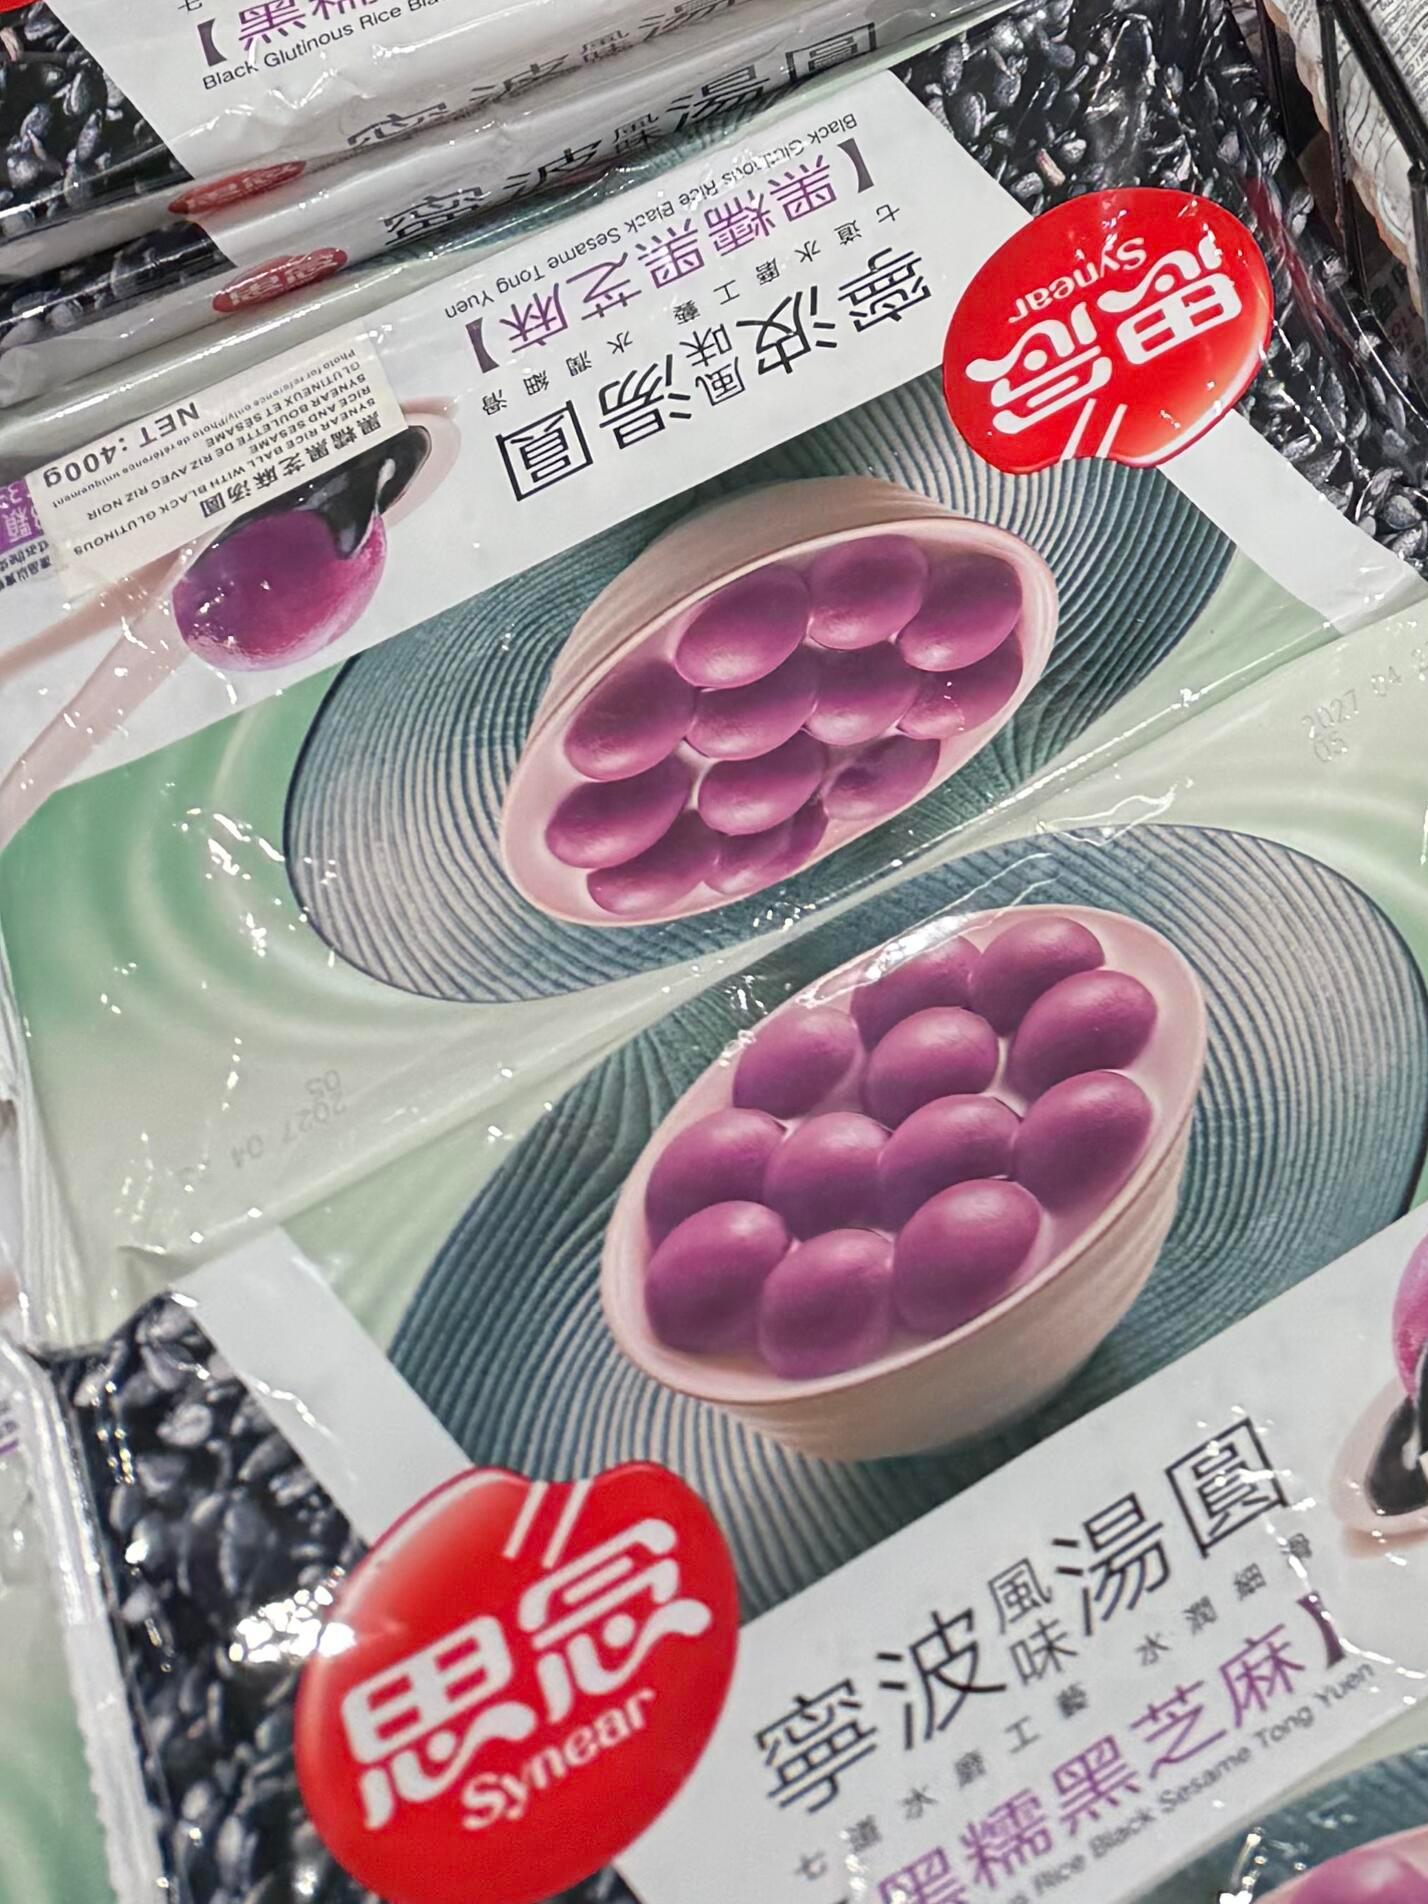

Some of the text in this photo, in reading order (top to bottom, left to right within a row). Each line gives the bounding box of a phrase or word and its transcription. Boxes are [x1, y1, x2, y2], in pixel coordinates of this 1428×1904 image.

[201, 59, 258, 91] Black
[262, 22, 355, 70] Glutinous
[359, 3, 402, 29] Rice
[442, 111, 858, 323] Black Black Sesame Tong Yuen
[459, 135, 877, 374] 【黑糯黑芝麻】
[999, 233, 1153, 330] Synear
[477, 195, 902, 421] 七道水磨工藝 水潤細滑
[485, 235, 941, 503] 寧波風味湯圓
[948, 231, 1252, 447] 思念
[40, 401, 200, 493] NET :400g
[72, 396, 376, 557] SYNEAR RICE BALL WITH BLACK GLUTINOUS
[85, 372, 366, 521] SYNEAR BOULETTE AVEC NOIR
[247, 384, 371, 454] RICE AND SESAME
[307, 1508, 730, 1832] 思念
[731, 1415, 1301, 1828] 寧波風味湯圓
[448, 1685, 665, 1840] Synear
[1153, 1658, 1377, 1816] Sesame Tong Yuen
